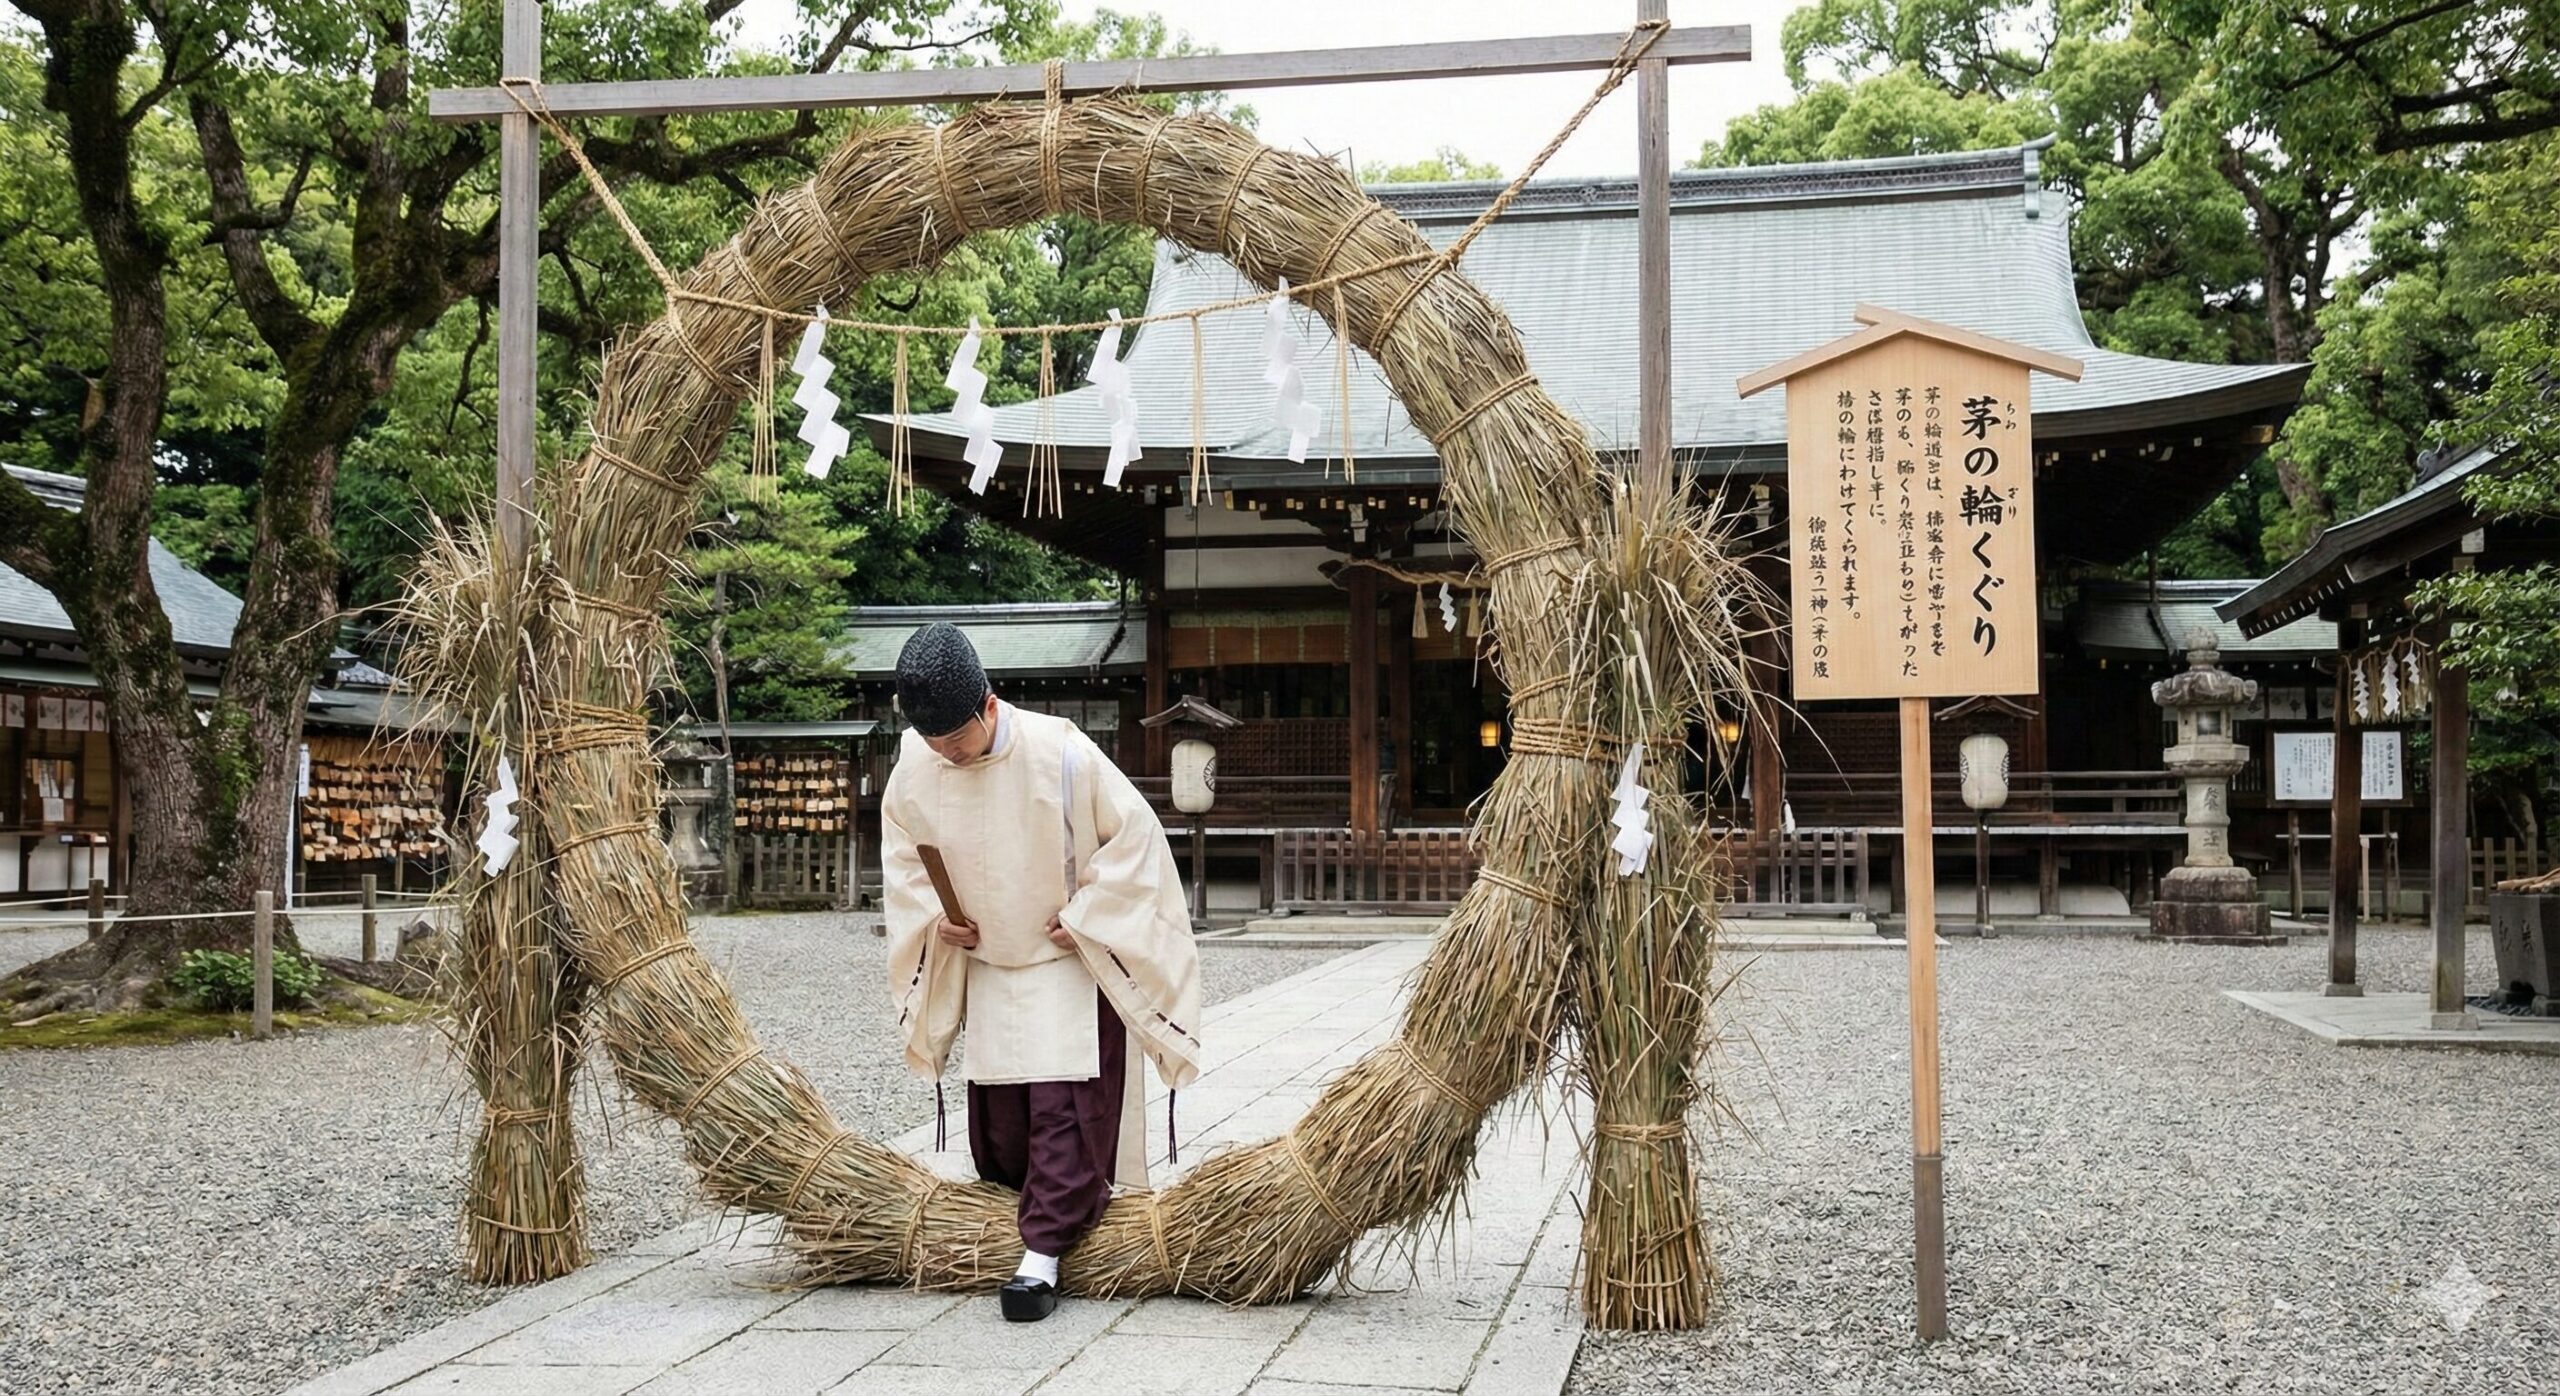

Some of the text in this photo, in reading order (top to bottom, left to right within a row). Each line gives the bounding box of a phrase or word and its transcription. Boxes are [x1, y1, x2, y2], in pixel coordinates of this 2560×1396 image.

[1958, 395, 2006, 657] 茅の輪くぐり
